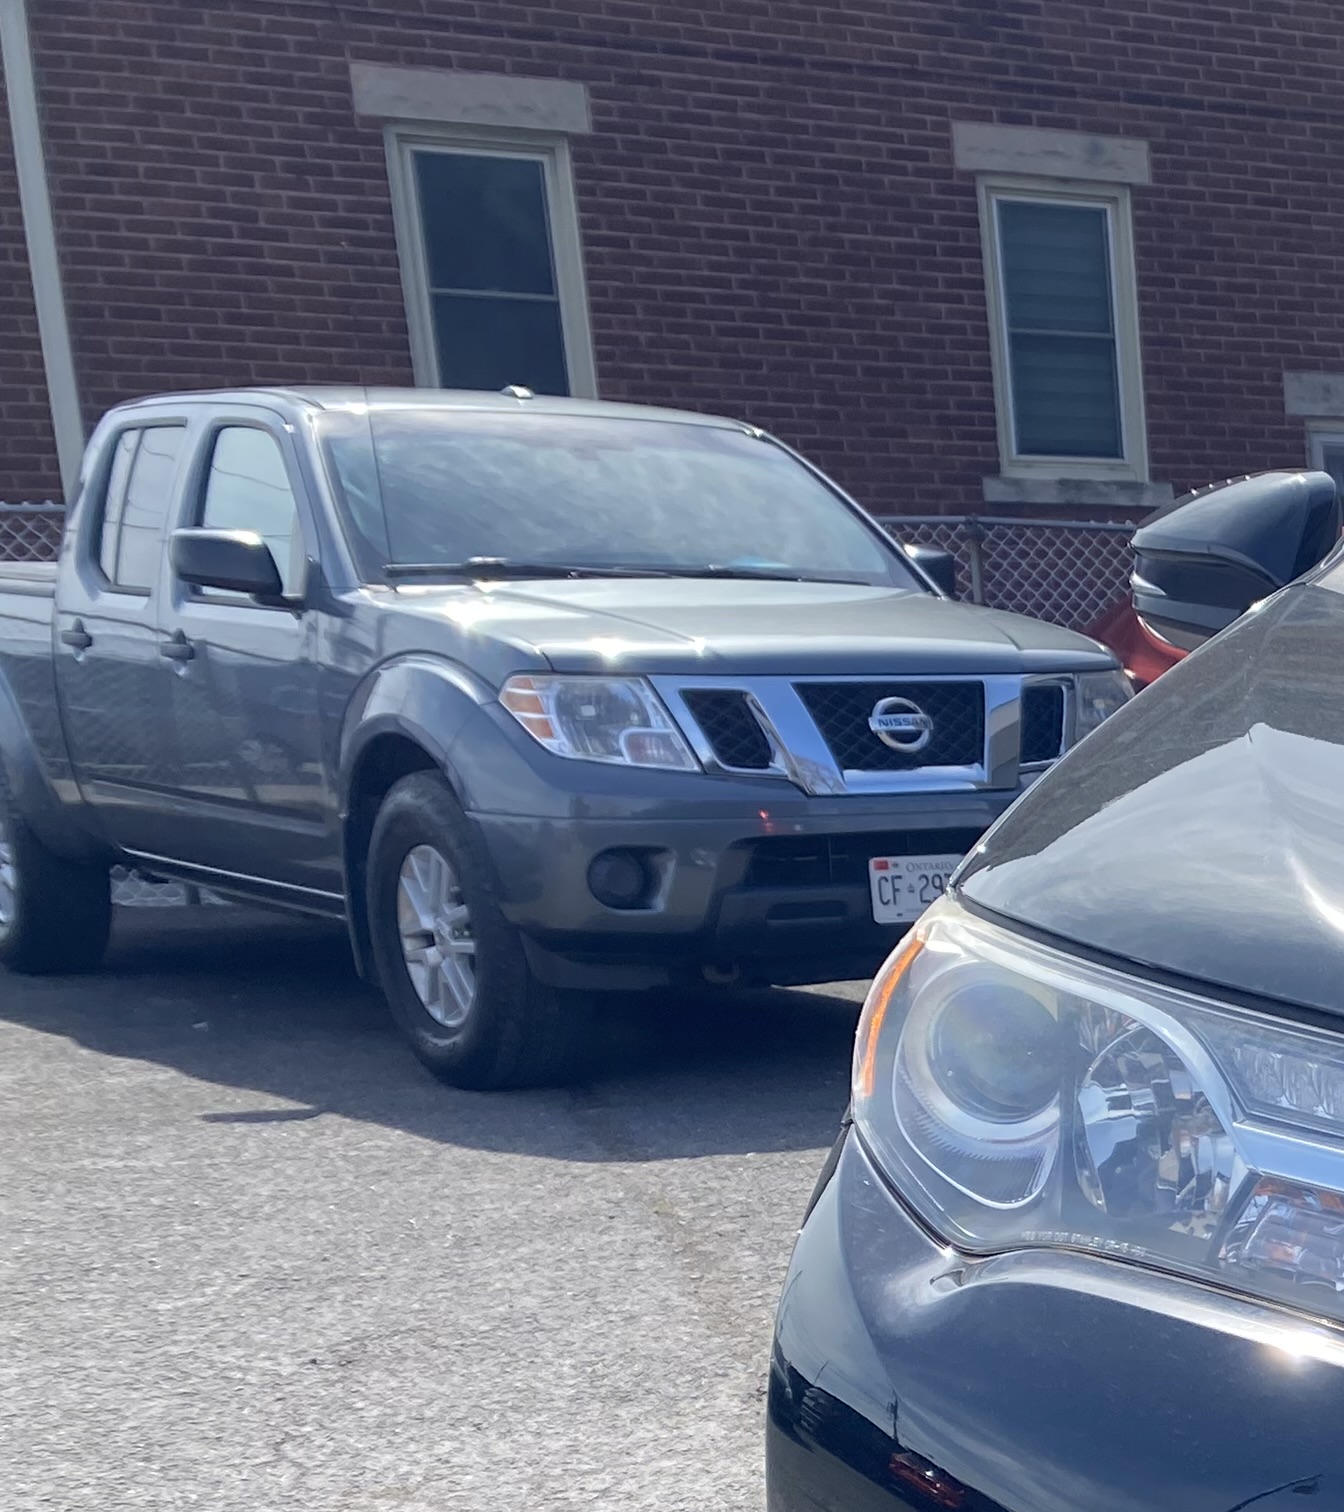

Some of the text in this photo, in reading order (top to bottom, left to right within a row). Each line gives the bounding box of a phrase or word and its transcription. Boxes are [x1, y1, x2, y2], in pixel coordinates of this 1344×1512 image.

[878, 717, 927, 728] NISSAN
[906, 861, 953, 872] ONTARIO
[878, 875, 902, 905] CF
